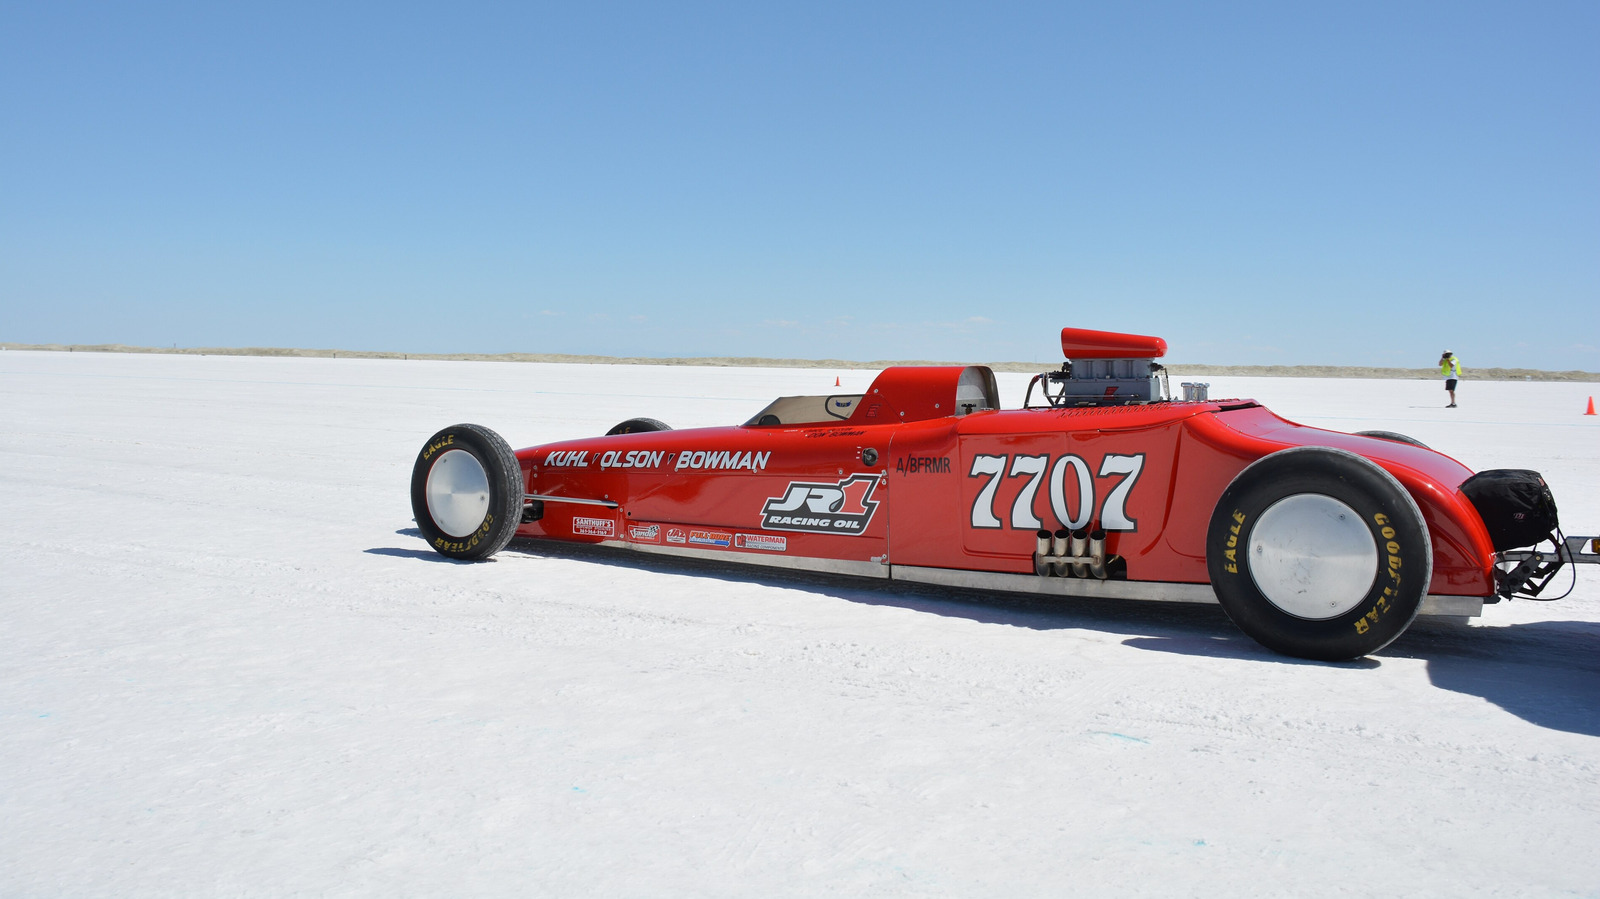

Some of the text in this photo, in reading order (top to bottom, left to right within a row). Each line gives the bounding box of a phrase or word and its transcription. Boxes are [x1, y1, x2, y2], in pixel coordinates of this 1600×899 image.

[423, 434, 454, 460] EAGLE
[544, 451, 772, 470] KUHL OLSON BOWMAN
[896, 454, 951, 477] A/BFRMR
[768, 480, 873, 515] JR1
[968, 453, 1146, 533] 7707
[769, 516, 860, 529] RACING OIL
[747, 534, 785, 544] WATERMAN
[1224, 509, 1246, 574] EAGLE
